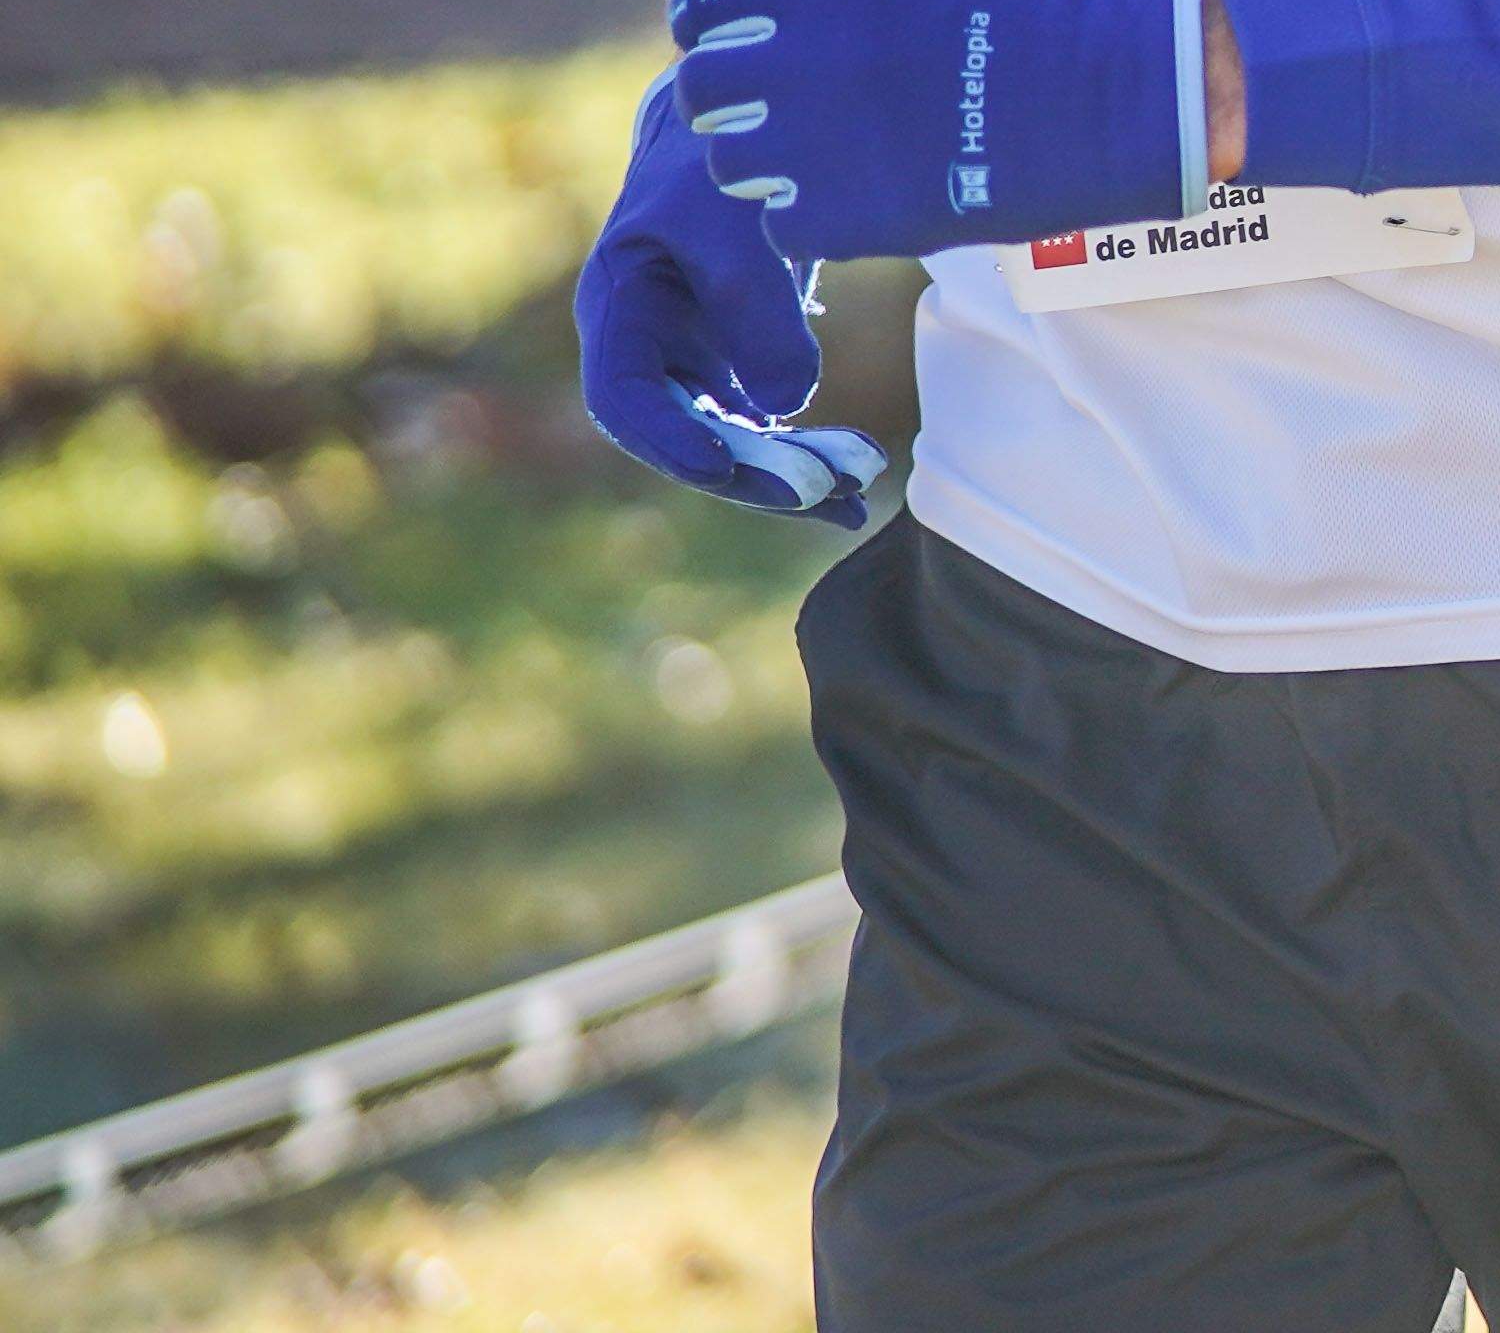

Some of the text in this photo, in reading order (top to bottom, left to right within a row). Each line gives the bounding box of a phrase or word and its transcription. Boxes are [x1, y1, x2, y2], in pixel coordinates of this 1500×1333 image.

[959, 11, 994, 152] Hotelopia
[1095, 214, 1269, 261] de Madrid
